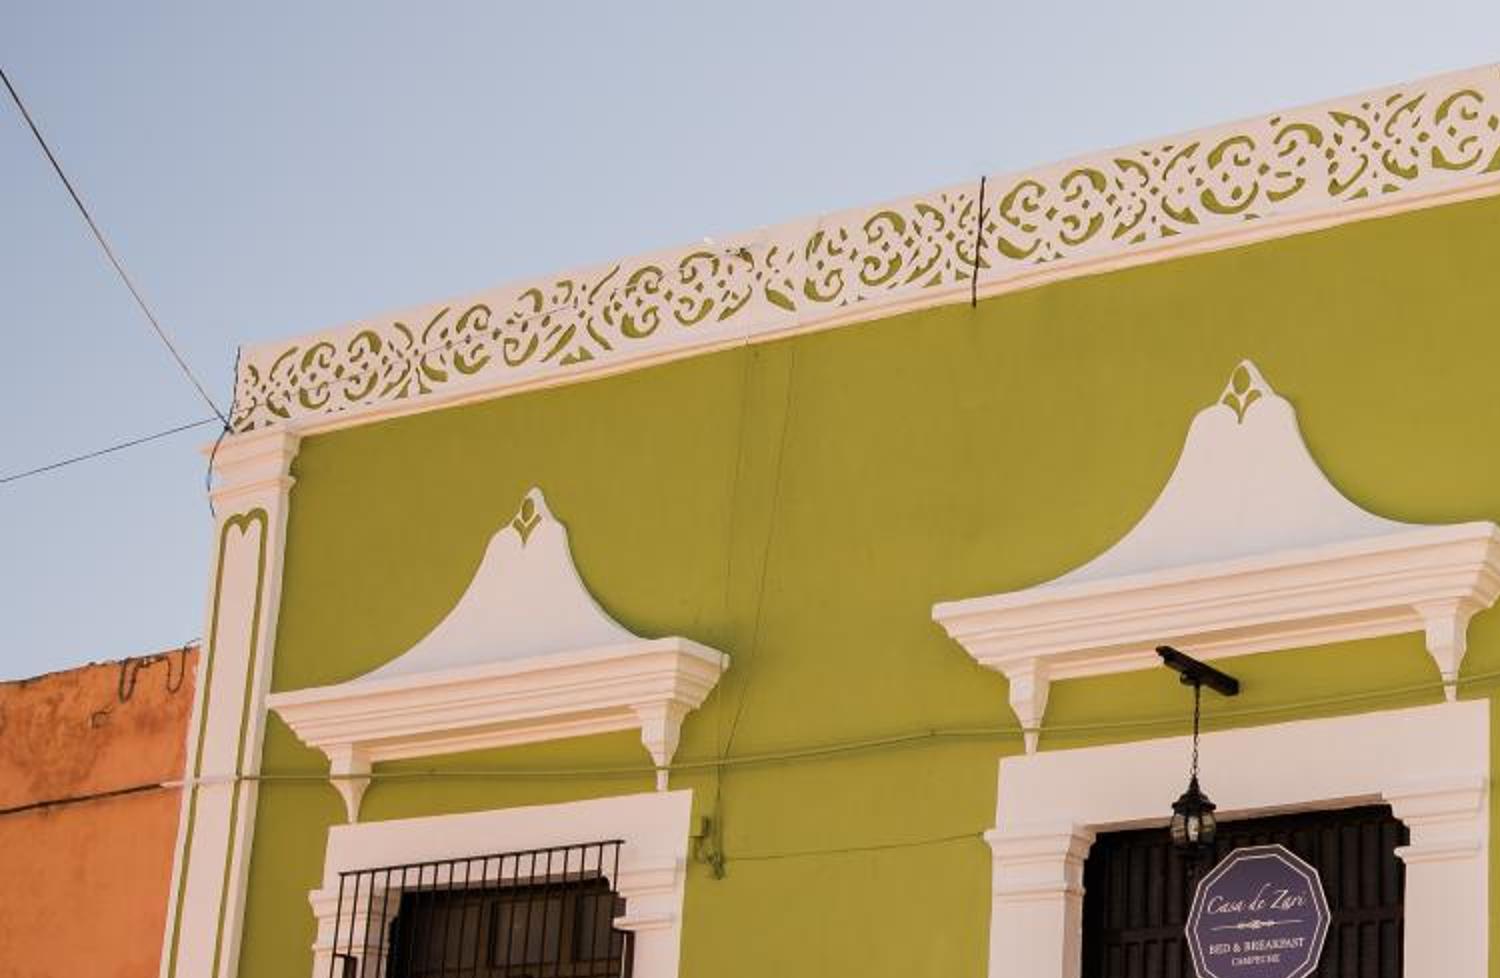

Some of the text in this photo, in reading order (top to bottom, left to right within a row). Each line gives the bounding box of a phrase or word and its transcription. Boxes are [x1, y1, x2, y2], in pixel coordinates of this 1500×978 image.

[1207, 895, 1246, 915] Casa
[1248, 883, 1270, 911] de
[1209, 937, 1305, 955] BED & BREAKFAST
